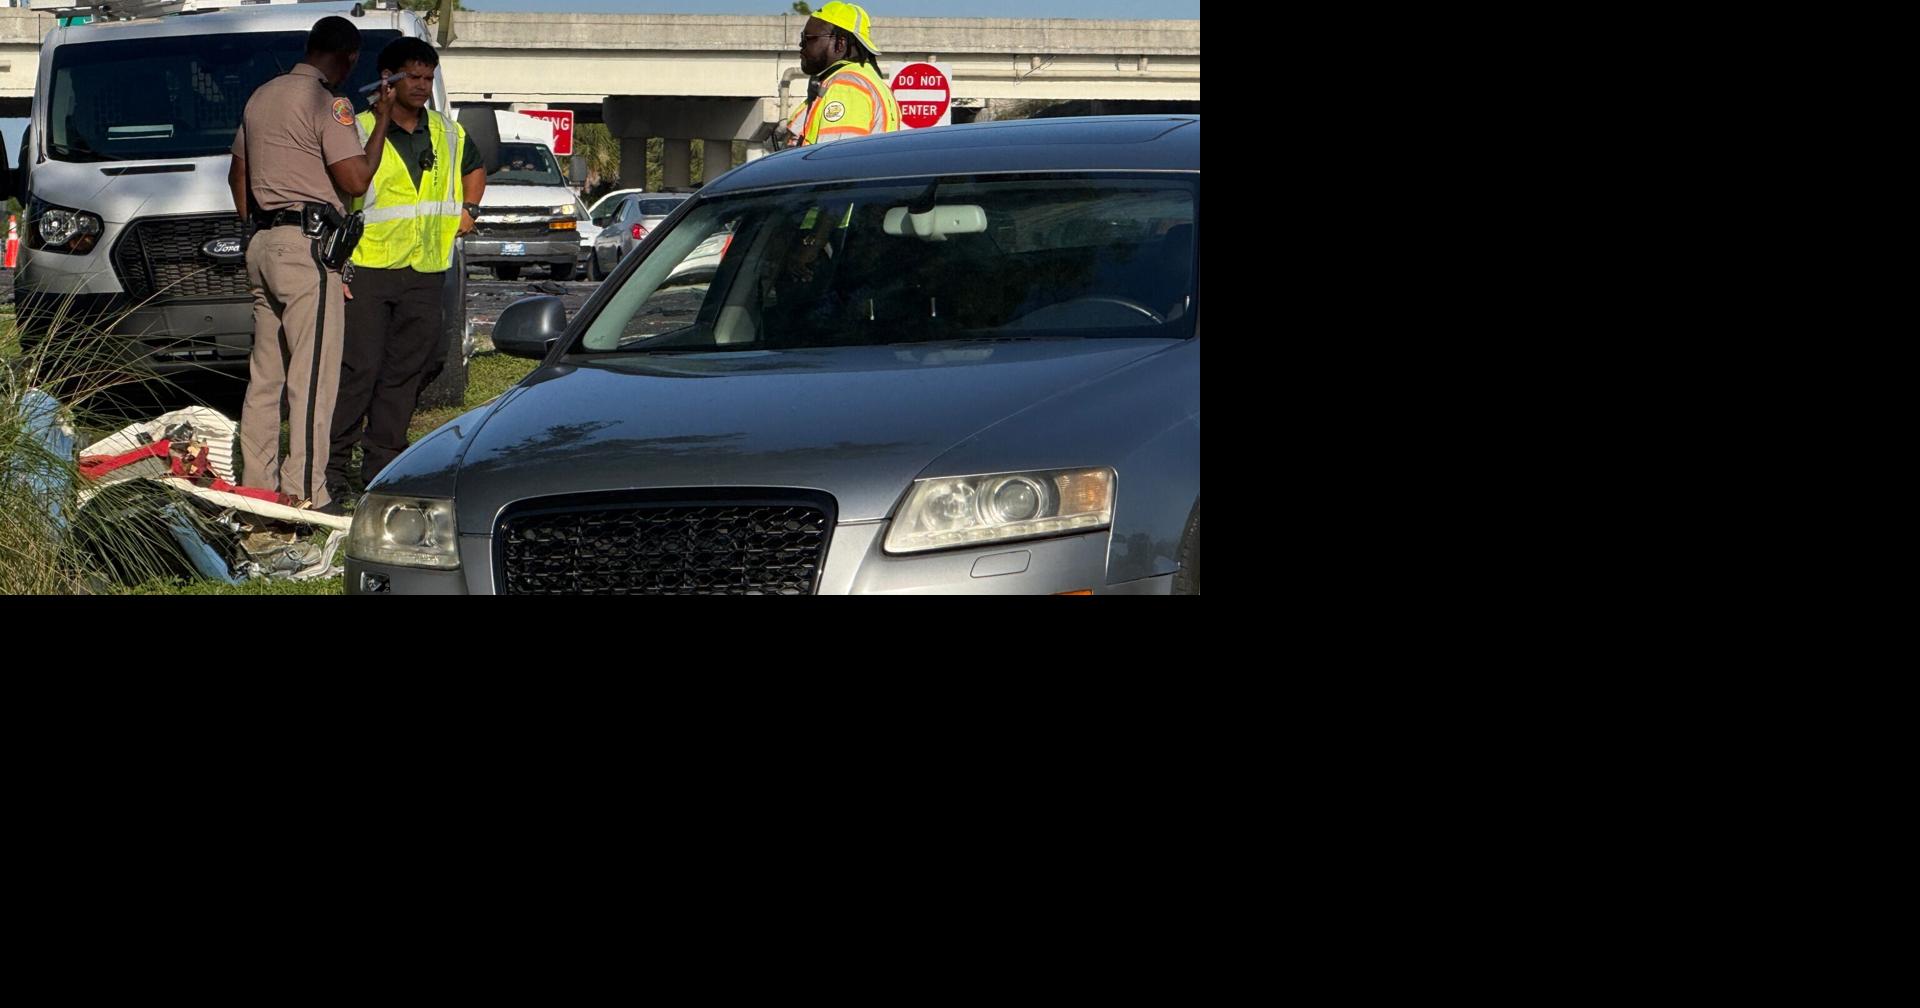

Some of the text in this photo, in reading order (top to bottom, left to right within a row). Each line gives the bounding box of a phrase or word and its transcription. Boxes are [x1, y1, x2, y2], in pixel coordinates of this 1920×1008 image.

[898, 75, 943, 86] DO NOT
[901, 104, 937, 116] ENTER
[213, 240, 241, 253] Ford
